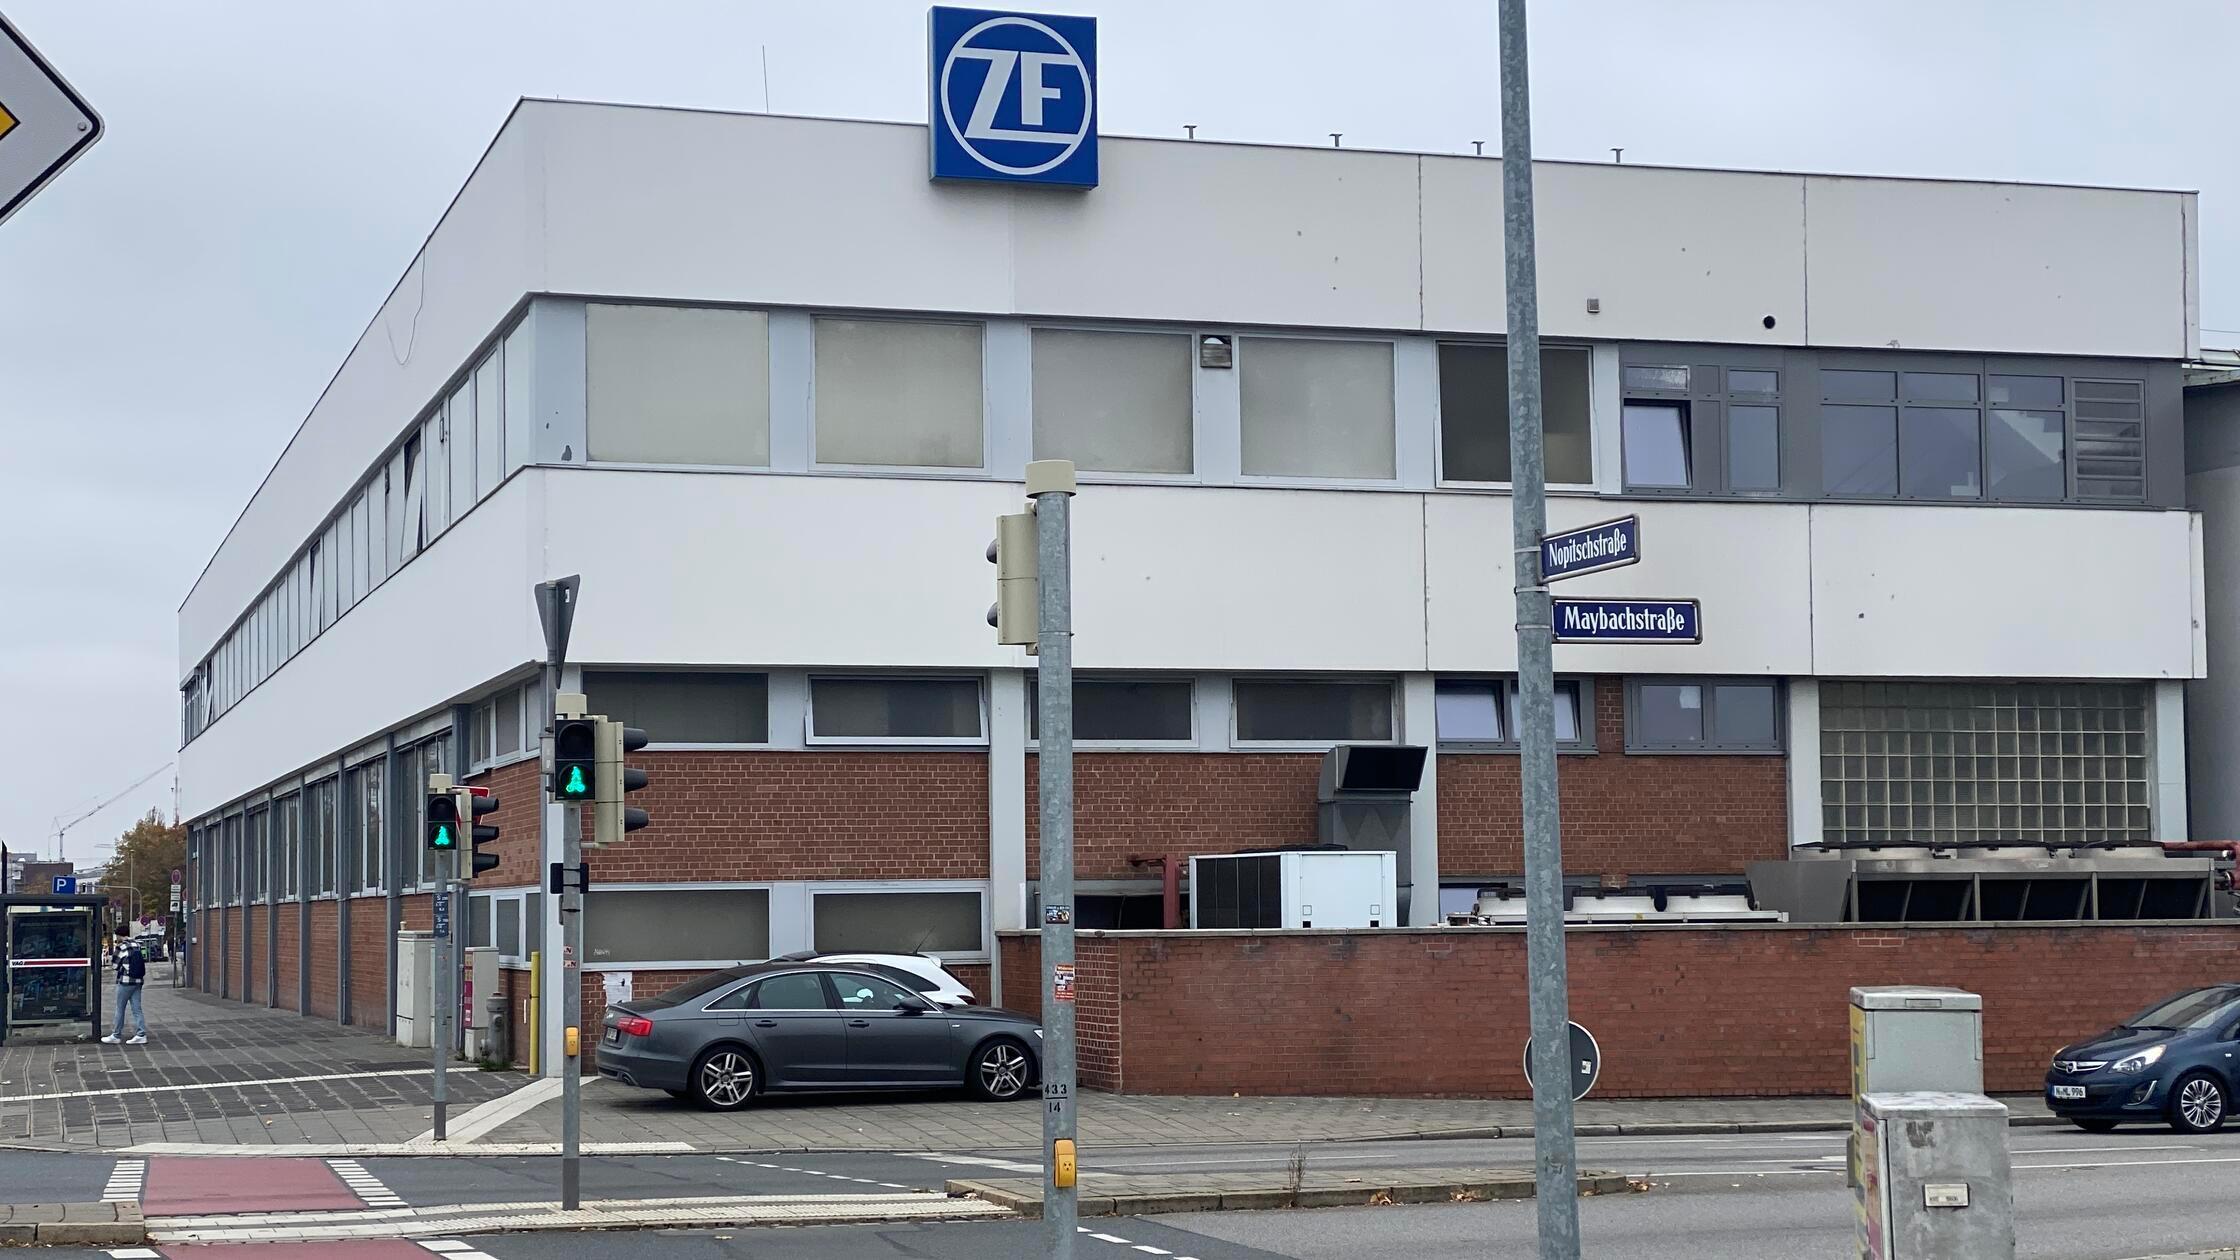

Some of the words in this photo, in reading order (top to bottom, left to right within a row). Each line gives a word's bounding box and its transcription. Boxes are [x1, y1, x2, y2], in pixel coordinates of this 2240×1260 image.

[951, 47, 1077, 145] ZF
[1549, 528, 1627, 568] Nopitschstraße
[1564, 606, 1685, 634] Maybachstraße
[56, 878, 67, 892] P
[1044, 1083, 1067, 1095] 433
[1049, 1101, 1061, 1113] 14
